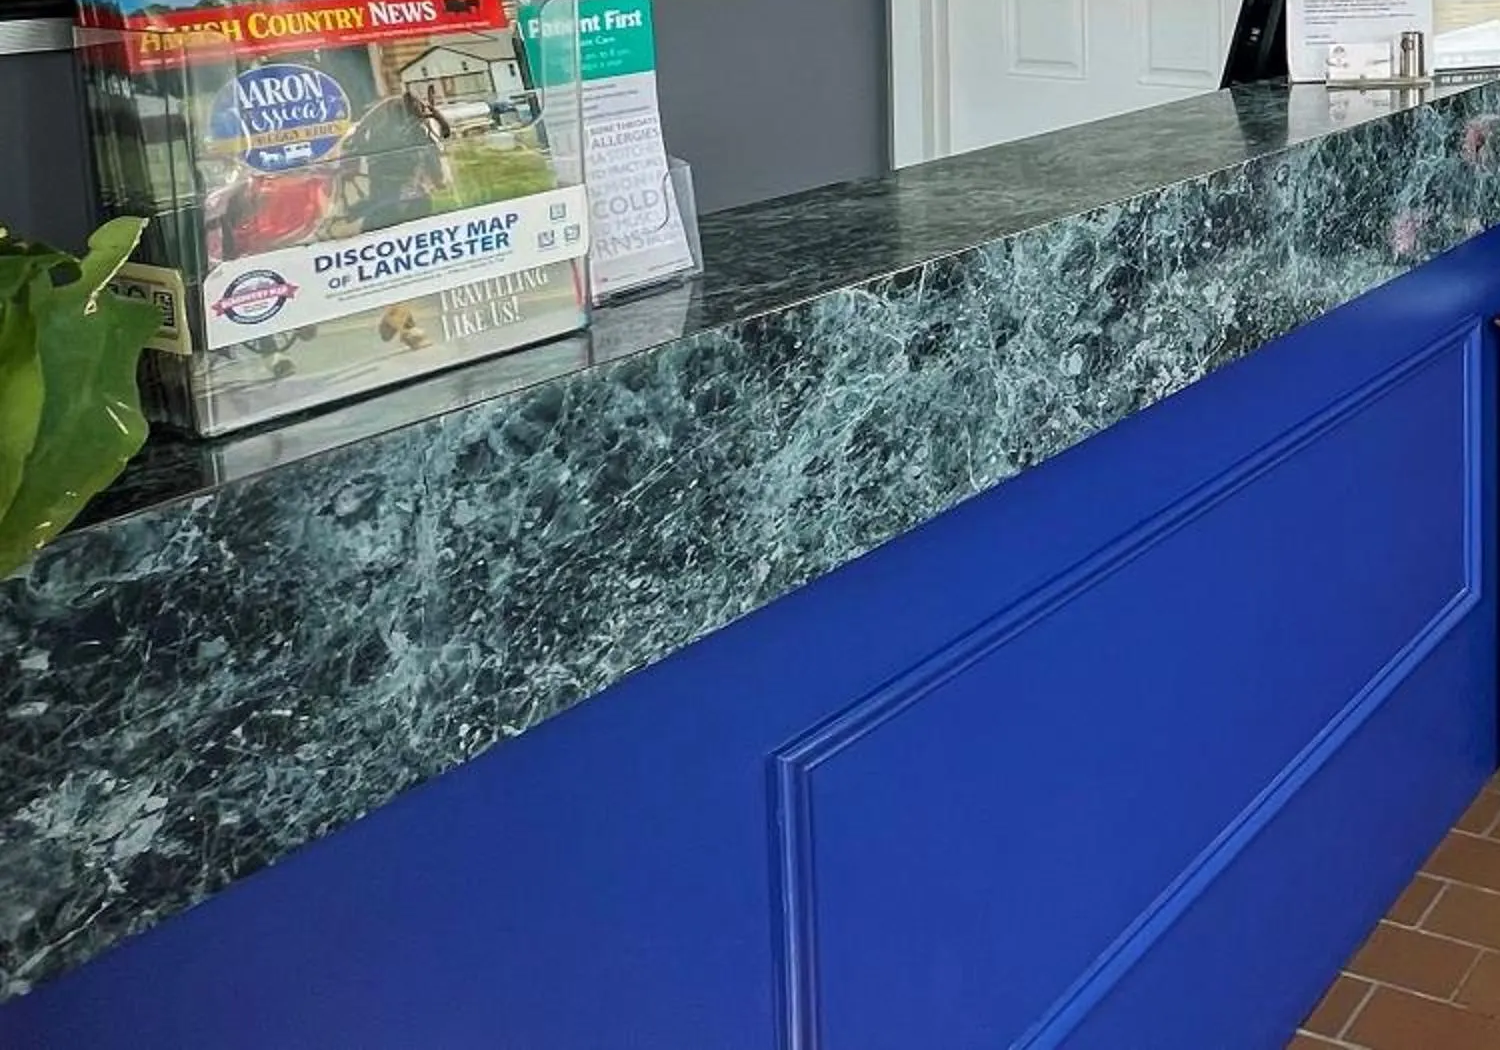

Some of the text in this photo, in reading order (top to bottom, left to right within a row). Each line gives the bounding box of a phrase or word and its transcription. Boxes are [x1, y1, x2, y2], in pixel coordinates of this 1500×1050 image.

[247, 5, 366, 40] COUNTRY
[367, 0, 438, 27] NEWS
[604, 9, 643, 31] First
[591, 127, 660, 150] ALLERGIES
[591, 189, 660, 220] COLD
[313, 212, 520, 275] DISCOVERY MAP
[328, 274, 352, 291] OF
[356, 231, 512, 283] LANCASTER
